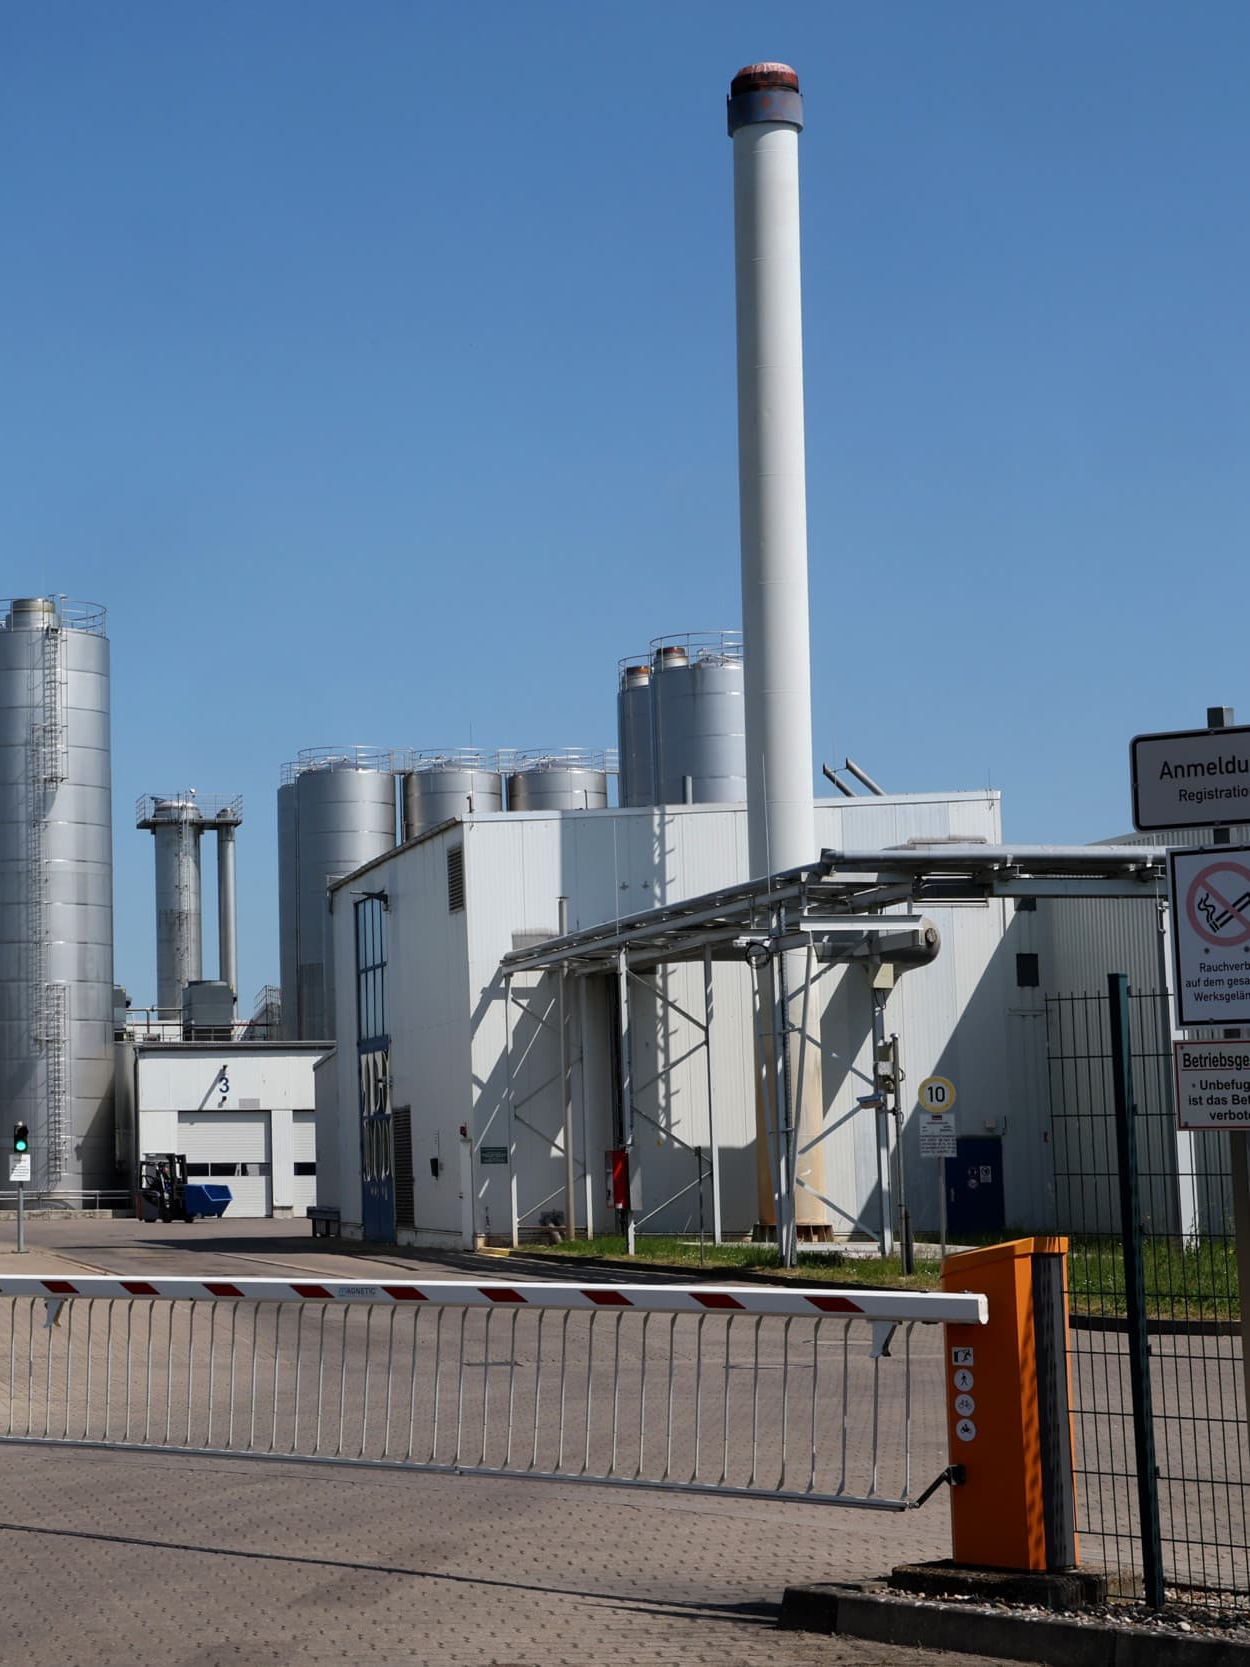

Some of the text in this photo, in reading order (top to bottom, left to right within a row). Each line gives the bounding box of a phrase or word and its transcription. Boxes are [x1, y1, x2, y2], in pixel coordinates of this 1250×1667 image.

[1159, 754, 1249, 780] Anmeldu
[1178, 784, 1250, 804] Registratio
[1199, 961, 1250, 973] Rauchverb
[1185, 977, 1250, 988] auf dem gesa
[1193, 990, 1250, 1003] Werksgelän
[1182, 1051, 1250, 1070] Betriebsge
[219, 1076, 230, 1094] 3
[1199, 1079, 1250, 1092] Unbefug
[927, 1086, 945, 1102] 10
[1188, 1095, 1203, 1106] ist
[1206, 1094, 1228, 1106] das
